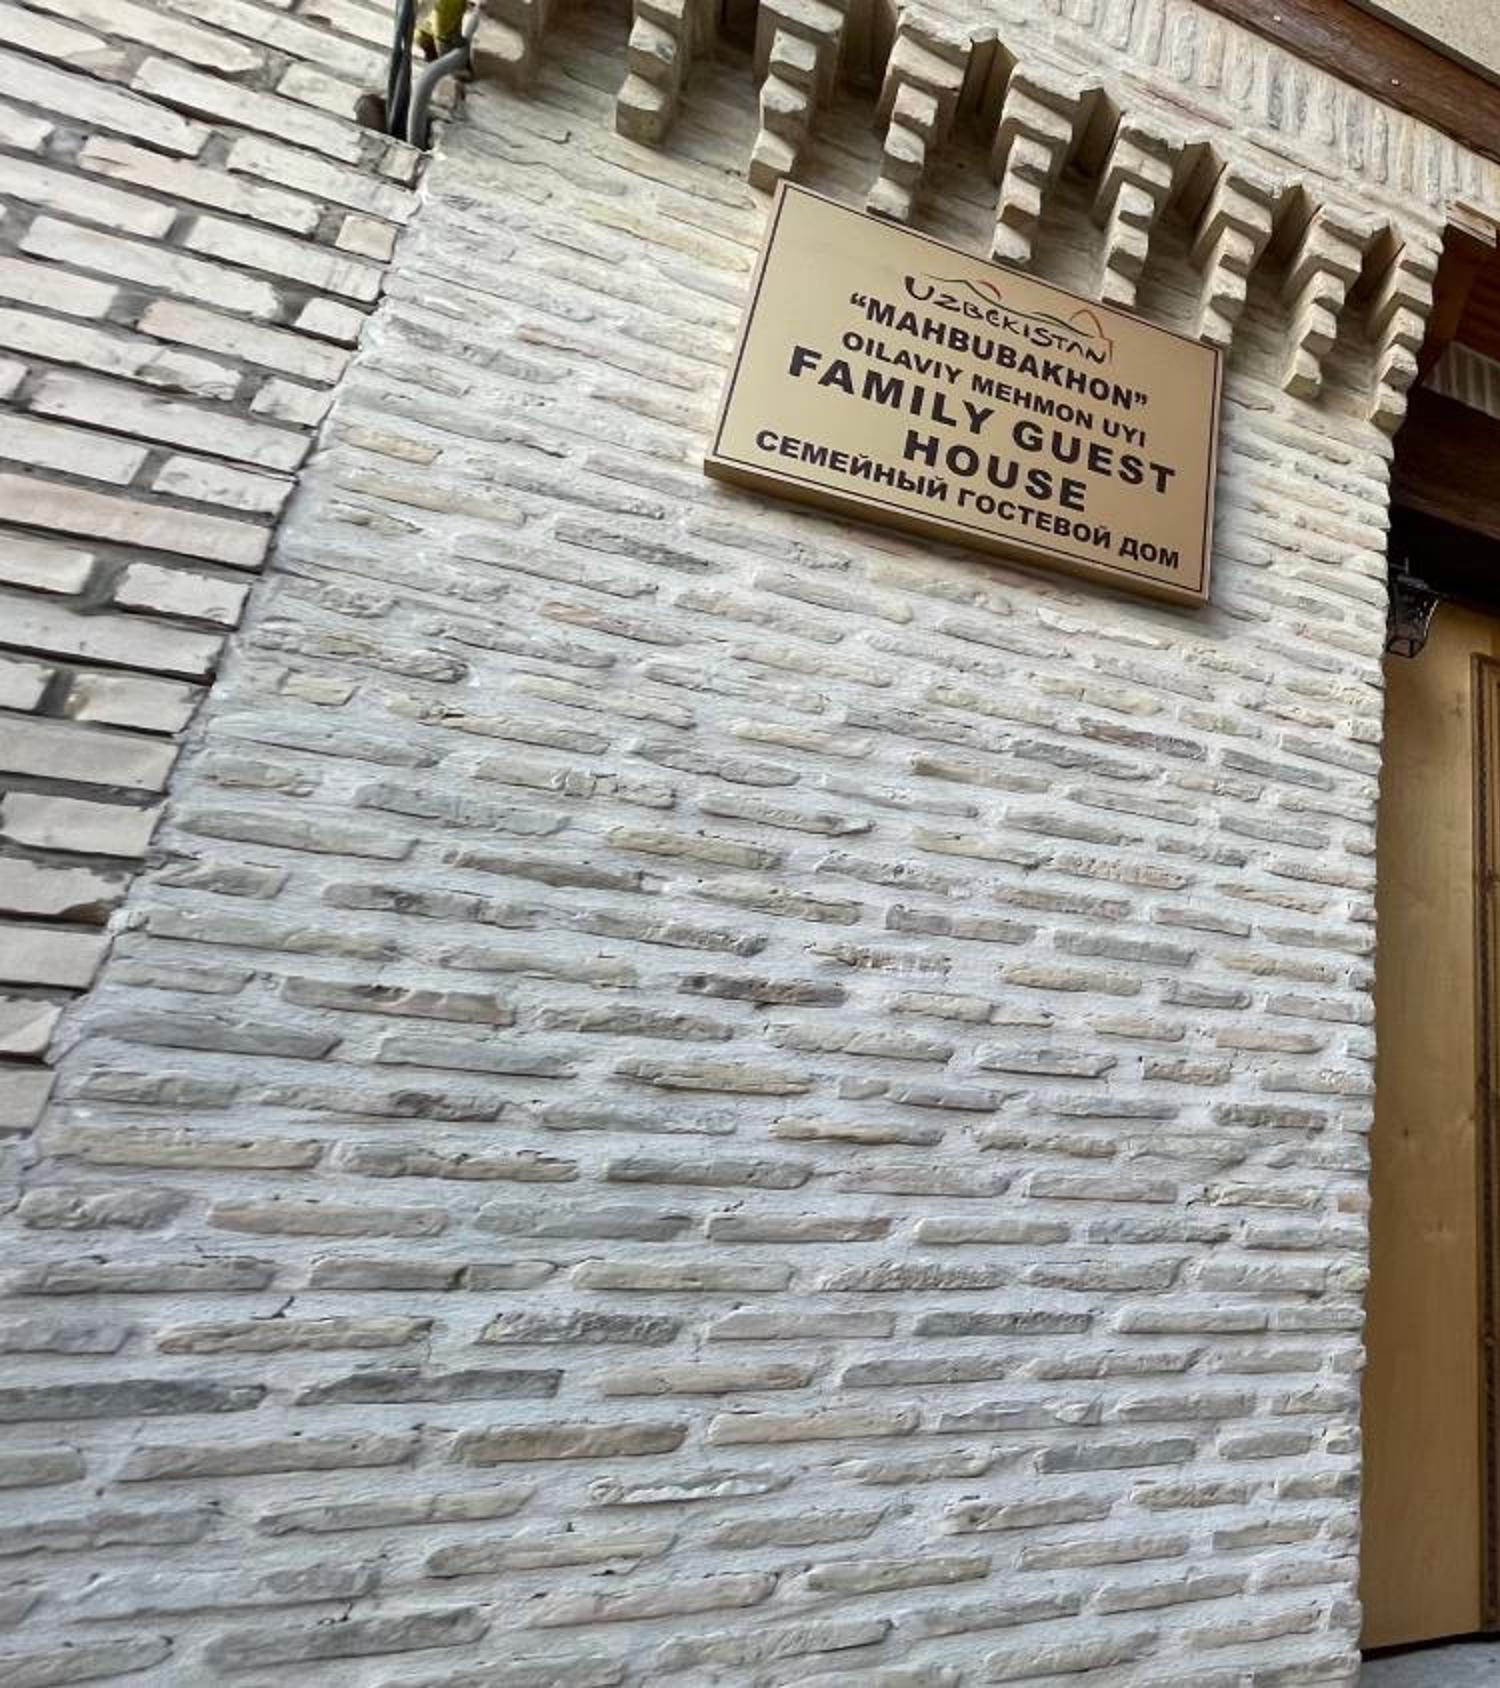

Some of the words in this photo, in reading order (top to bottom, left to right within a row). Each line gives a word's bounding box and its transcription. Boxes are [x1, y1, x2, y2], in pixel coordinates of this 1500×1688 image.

[842, 332, 964, 385] OILAVIY
[971, 373, 1093, 430] MEHMON
[1102, 418, 1147, 448] UYI
[850, 292, 1148, 410] “MAHBUBAKHON”
[789, 345, 996, 435] FAMILY
[1012, 420, 1176, 494] GUEST
[903, 429, 1088, 513] HOUSE
[756, 430, 949, 501] СЕМЕЙНЫЙ
[957, 487, 1111, 548] ГОСТЕВОЙ
[1118, 536, 1180, 570] ДОМ
